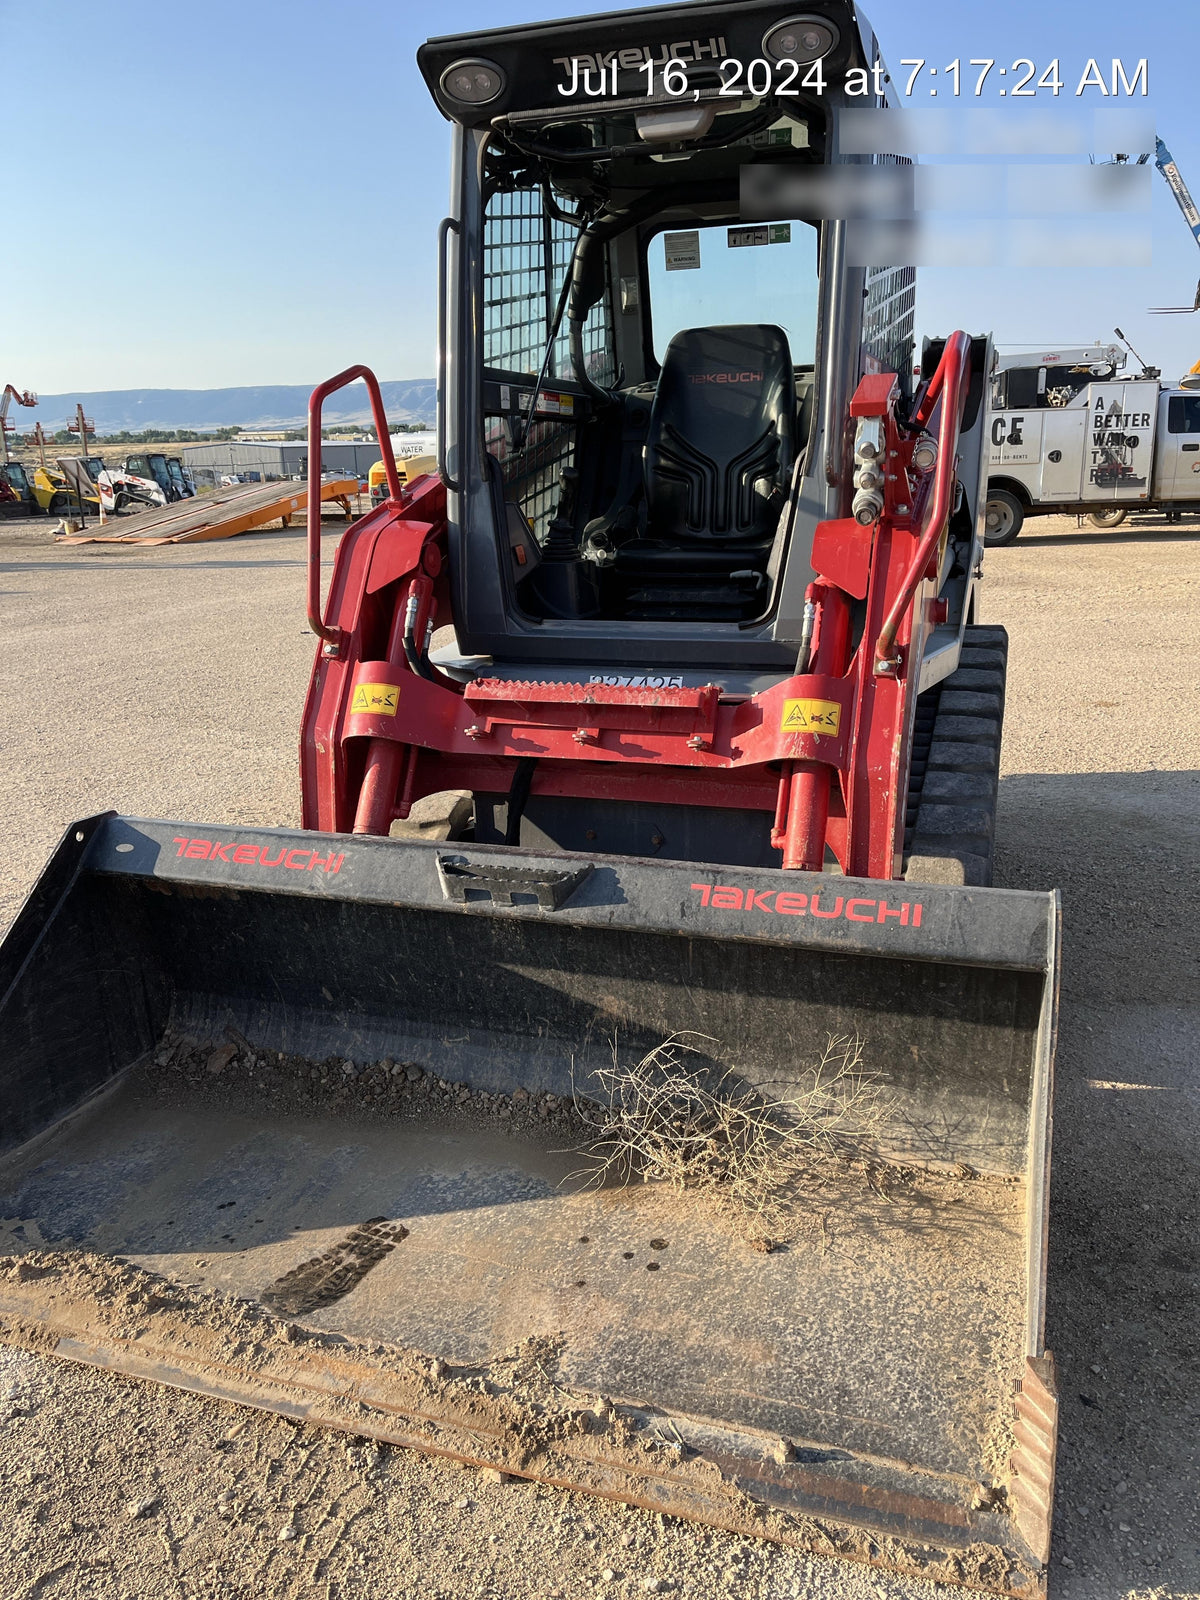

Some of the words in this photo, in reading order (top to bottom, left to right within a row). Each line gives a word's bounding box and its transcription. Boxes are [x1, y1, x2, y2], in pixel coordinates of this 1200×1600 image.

[688, 371, 764, 384] TAKEUCHI
[1094, 396, 1105, 411] A
[1094, 412, 1151, 429] BETTER
[400, 445, 424, 454] WATER
[172, 837, 346, 874] TAKEUCHI
[690, 883, 923, 928] TAKEUCHI
